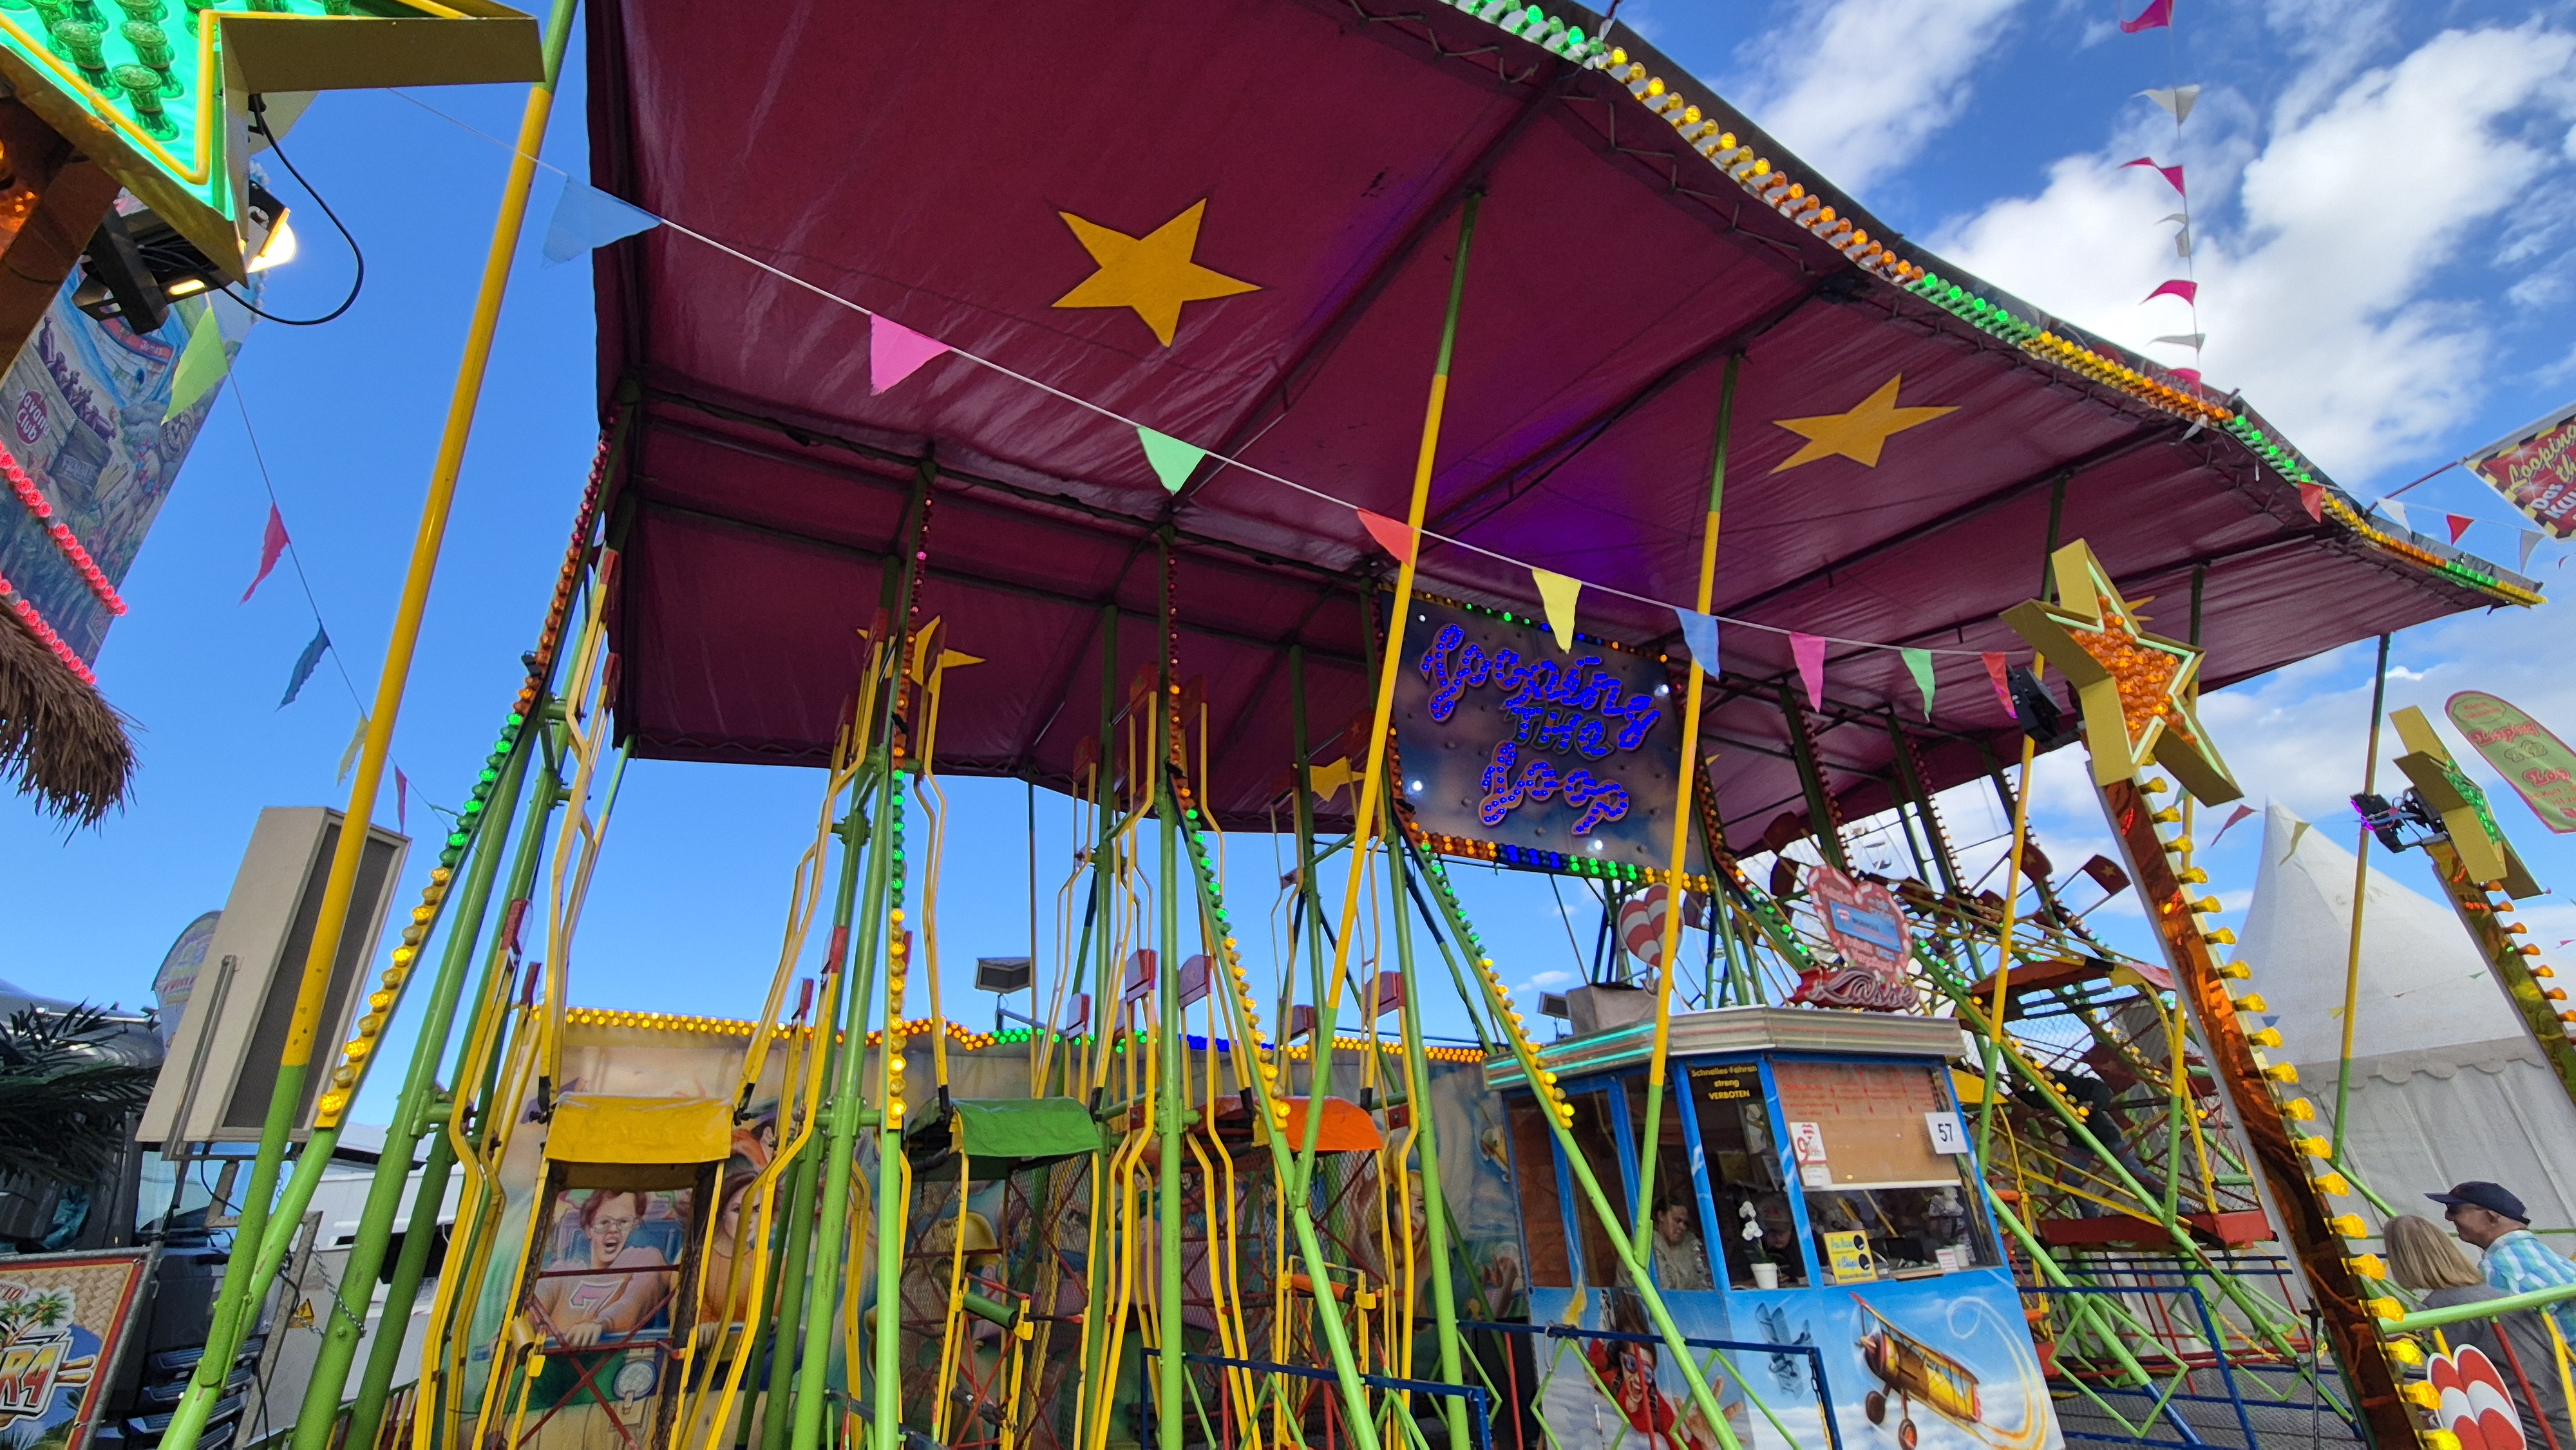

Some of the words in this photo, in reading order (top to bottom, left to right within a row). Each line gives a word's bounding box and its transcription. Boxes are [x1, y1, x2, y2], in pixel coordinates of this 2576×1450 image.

[17, 408, 37, 441] Club
[1420, 623, 1661, 751] Looping
[1479, 741, 1629, 835] Loop
[1690, 1068, 1728, 1077] Schnelles
[1714, 1079, 1740, 1088] streng
[1707, 1089, 1750, 1100] VERBOTEN
[1937, 1123, 1954, 1142] 57
